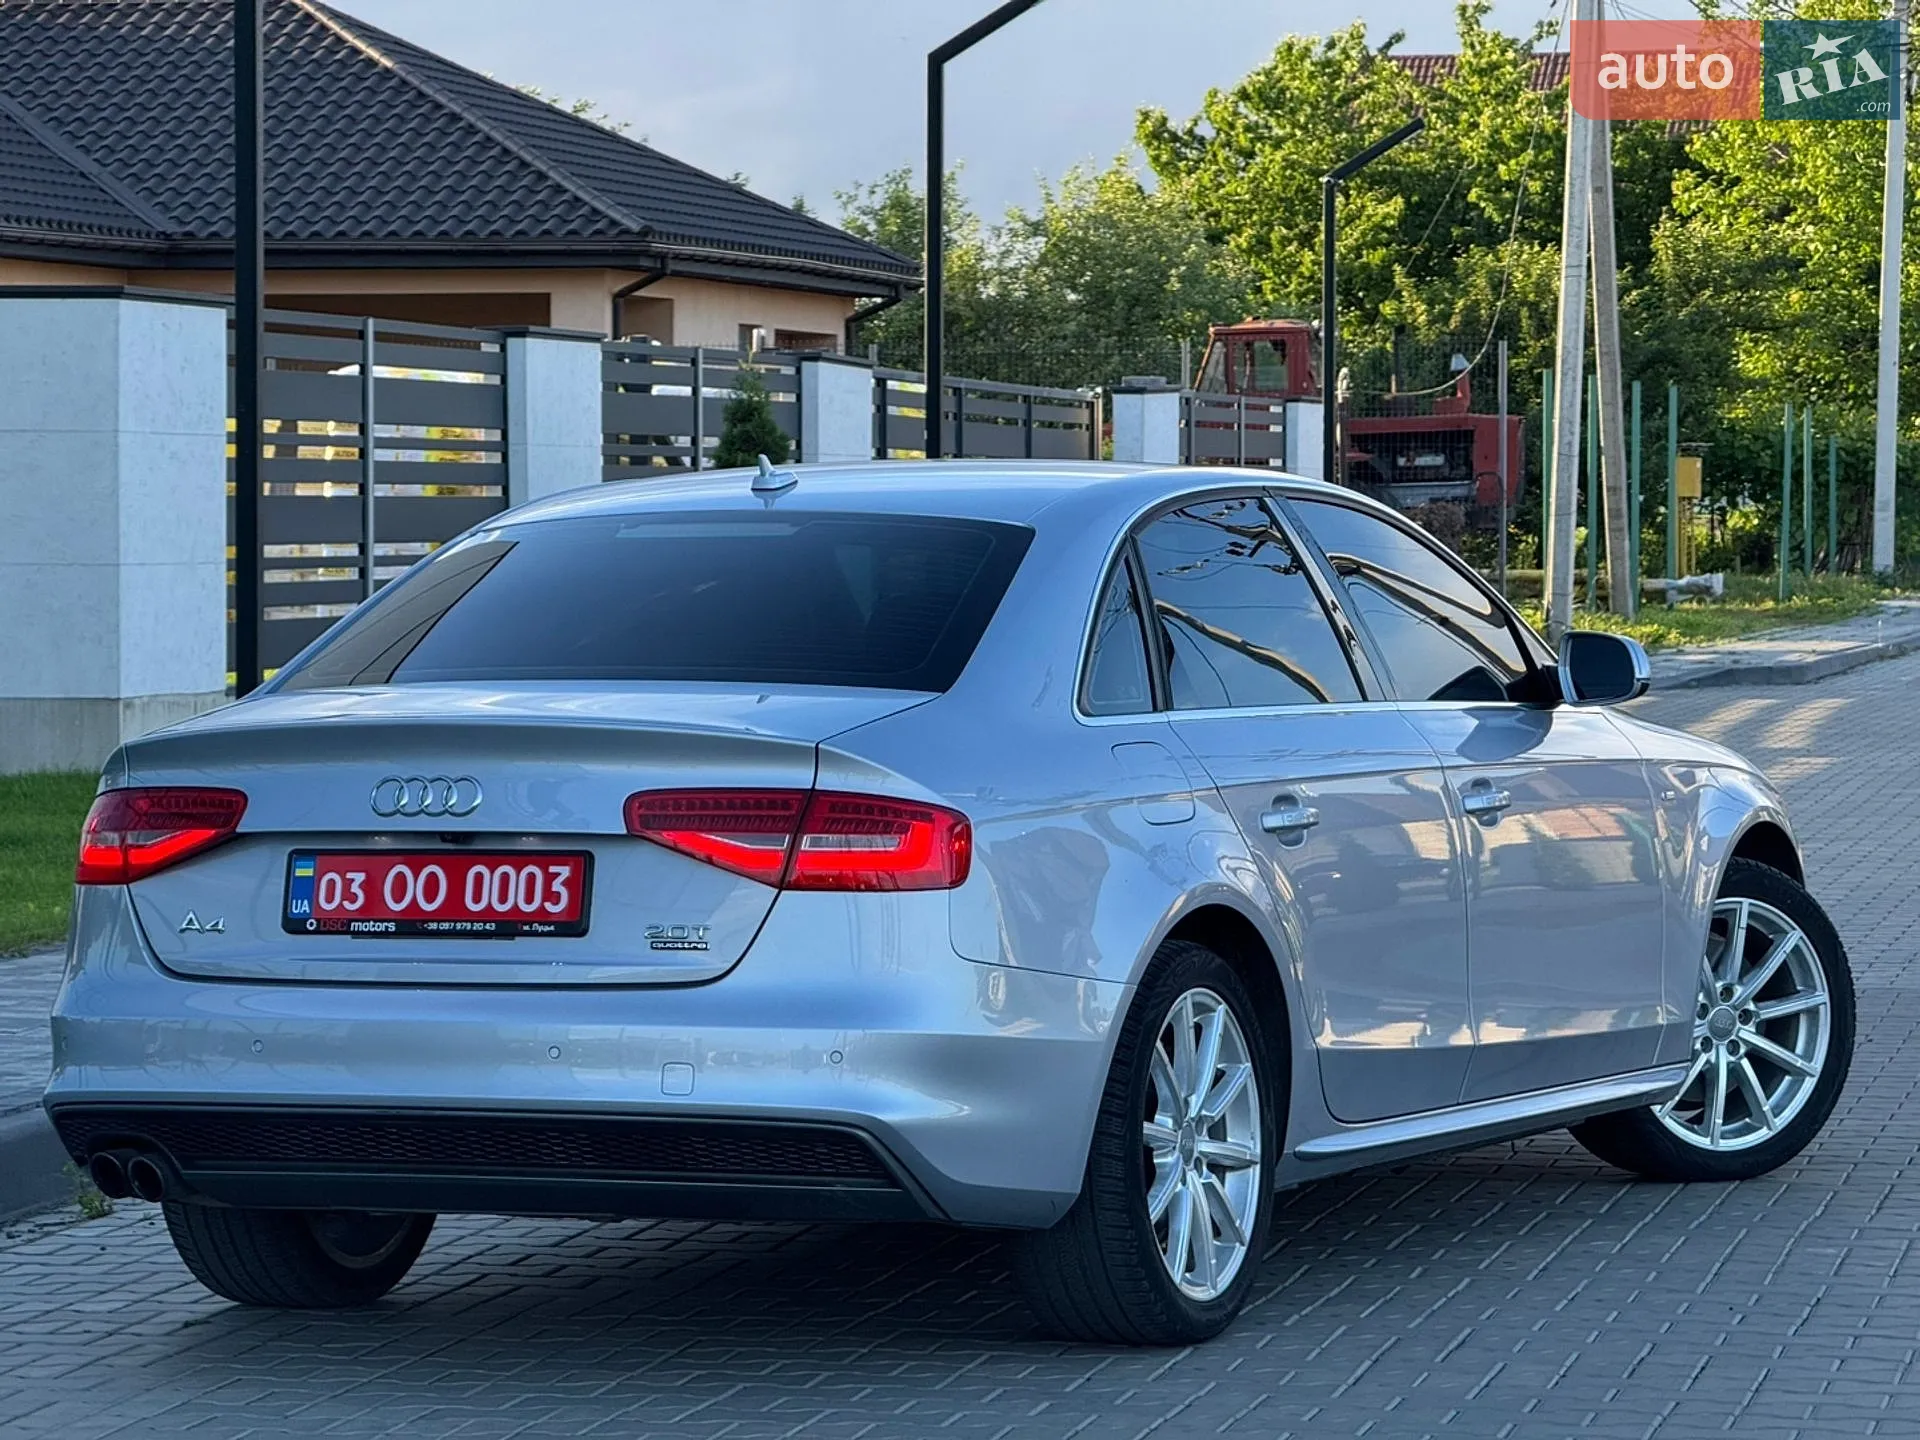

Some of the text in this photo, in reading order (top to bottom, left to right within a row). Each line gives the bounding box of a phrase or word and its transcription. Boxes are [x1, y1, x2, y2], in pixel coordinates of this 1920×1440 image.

[318, 871, 367, 911] 03
[464, 864, 571, 914] 0003
[292, 899, 310, 914] UA
[178, 910, 225, 935] A4
[350, 920, 396, 932] motors
[472, 922, 484, 931] 20
[484, 922, 496, 931] 43
